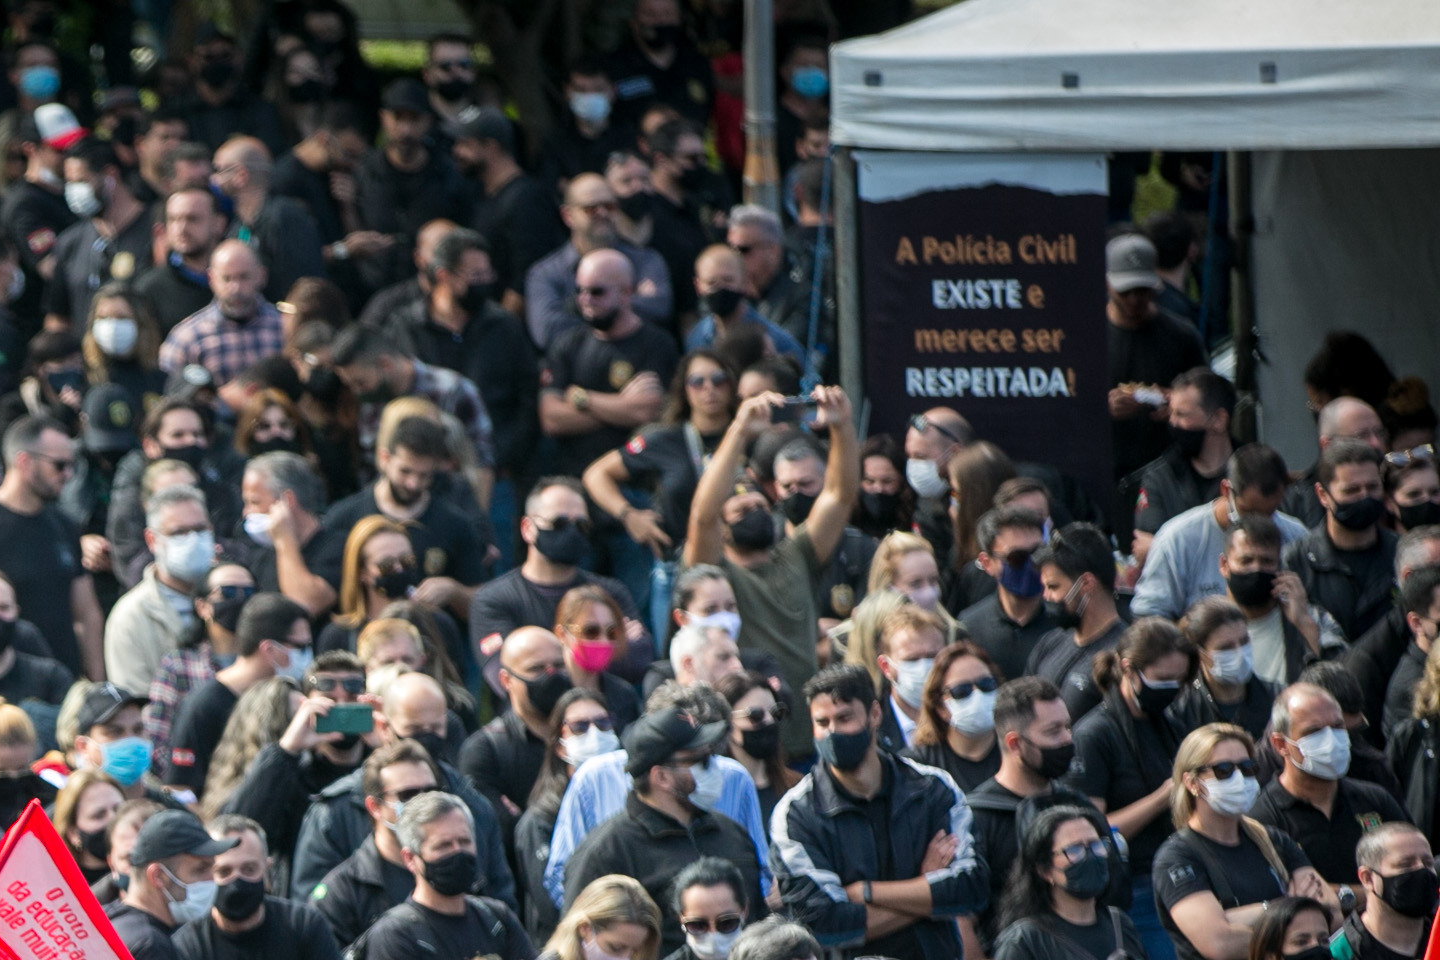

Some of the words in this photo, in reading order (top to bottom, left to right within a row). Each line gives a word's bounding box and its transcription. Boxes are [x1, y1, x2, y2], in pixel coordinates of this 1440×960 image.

[895, 236, 918, 265] A
[922, 234, 1012, 265] Polícia
[1018, 233, 1077, 264] Civil
[932, 278, 1023, 309] EXISTE
[1026, 284, 1045, 309] e
[914, 328, 1017, 353] merece
[1021, 328, 1065, 353] ser
[905, 367, 1076, 397] RESPEITADA!
[7, 880, 31, 902] da
[58, 902, 89, 940] voto
